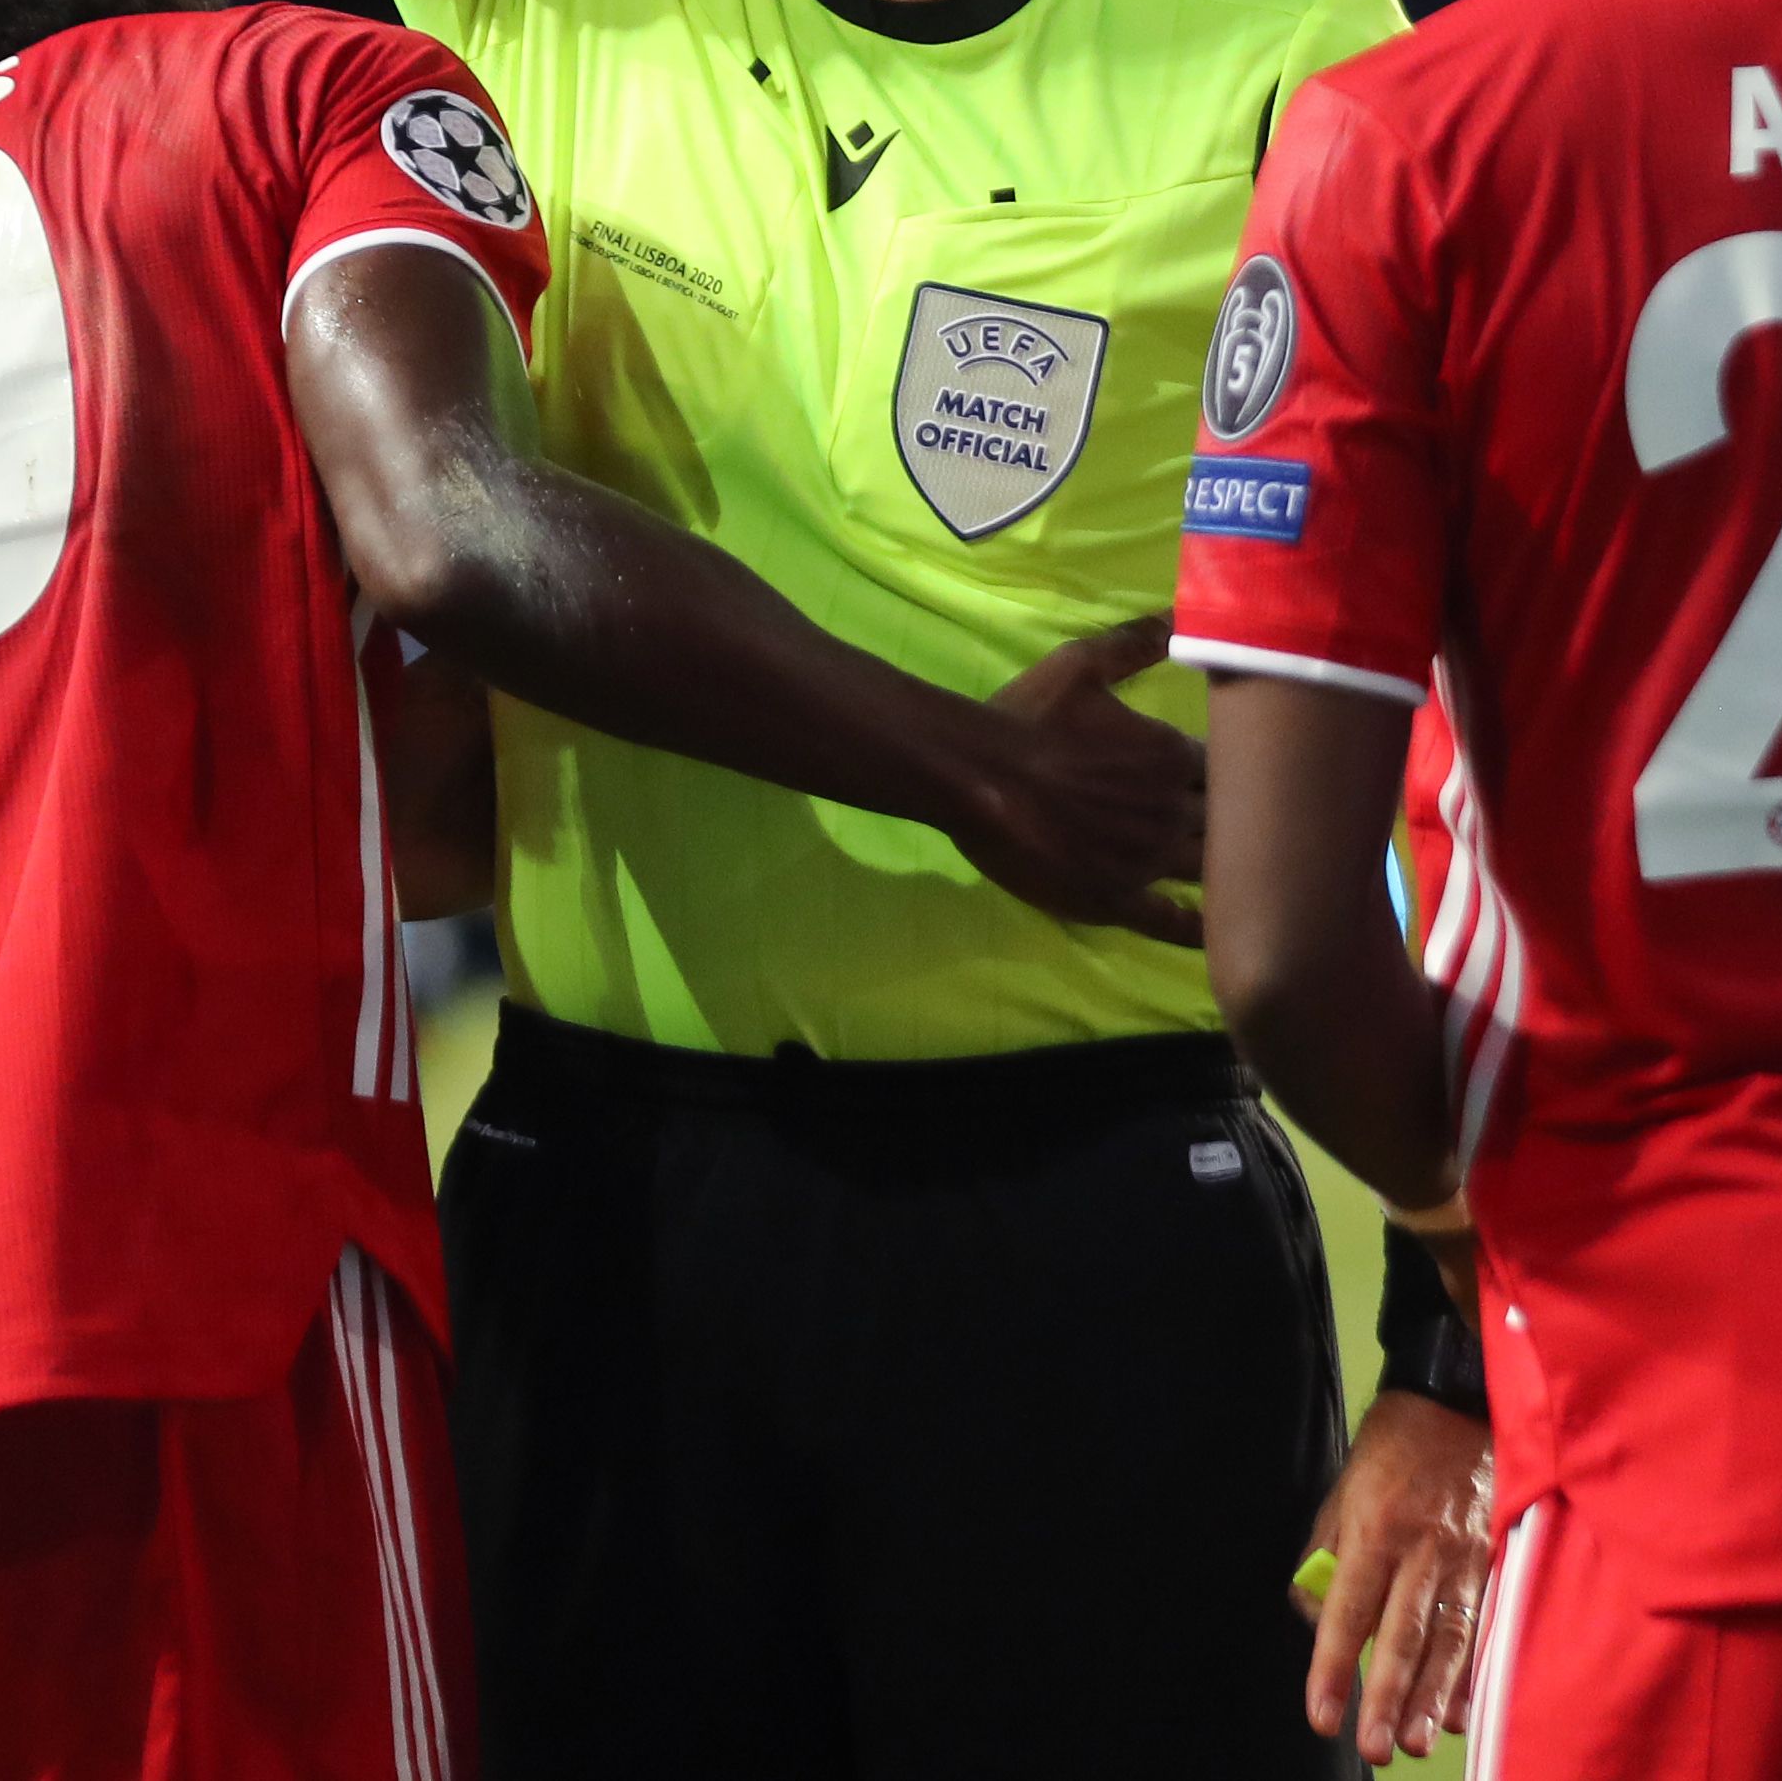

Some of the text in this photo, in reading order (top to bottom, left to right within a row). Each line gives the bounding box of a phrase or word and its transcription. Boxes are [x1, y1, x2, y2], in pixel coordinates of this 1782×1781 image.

[590, 220, 631, 253] FINAL
[634, 241, 686, 278] LISBOA
[689, 267, 723, 295] 2020
[707, 298, 740, 320] AUGUST
[944, 324, 1057, 380] UEFA
[1227, 343, 1253, 392] 5
[934, 387, 1047, 434] MATCH
[914, 420, 1049, 473] OFFICIAL
